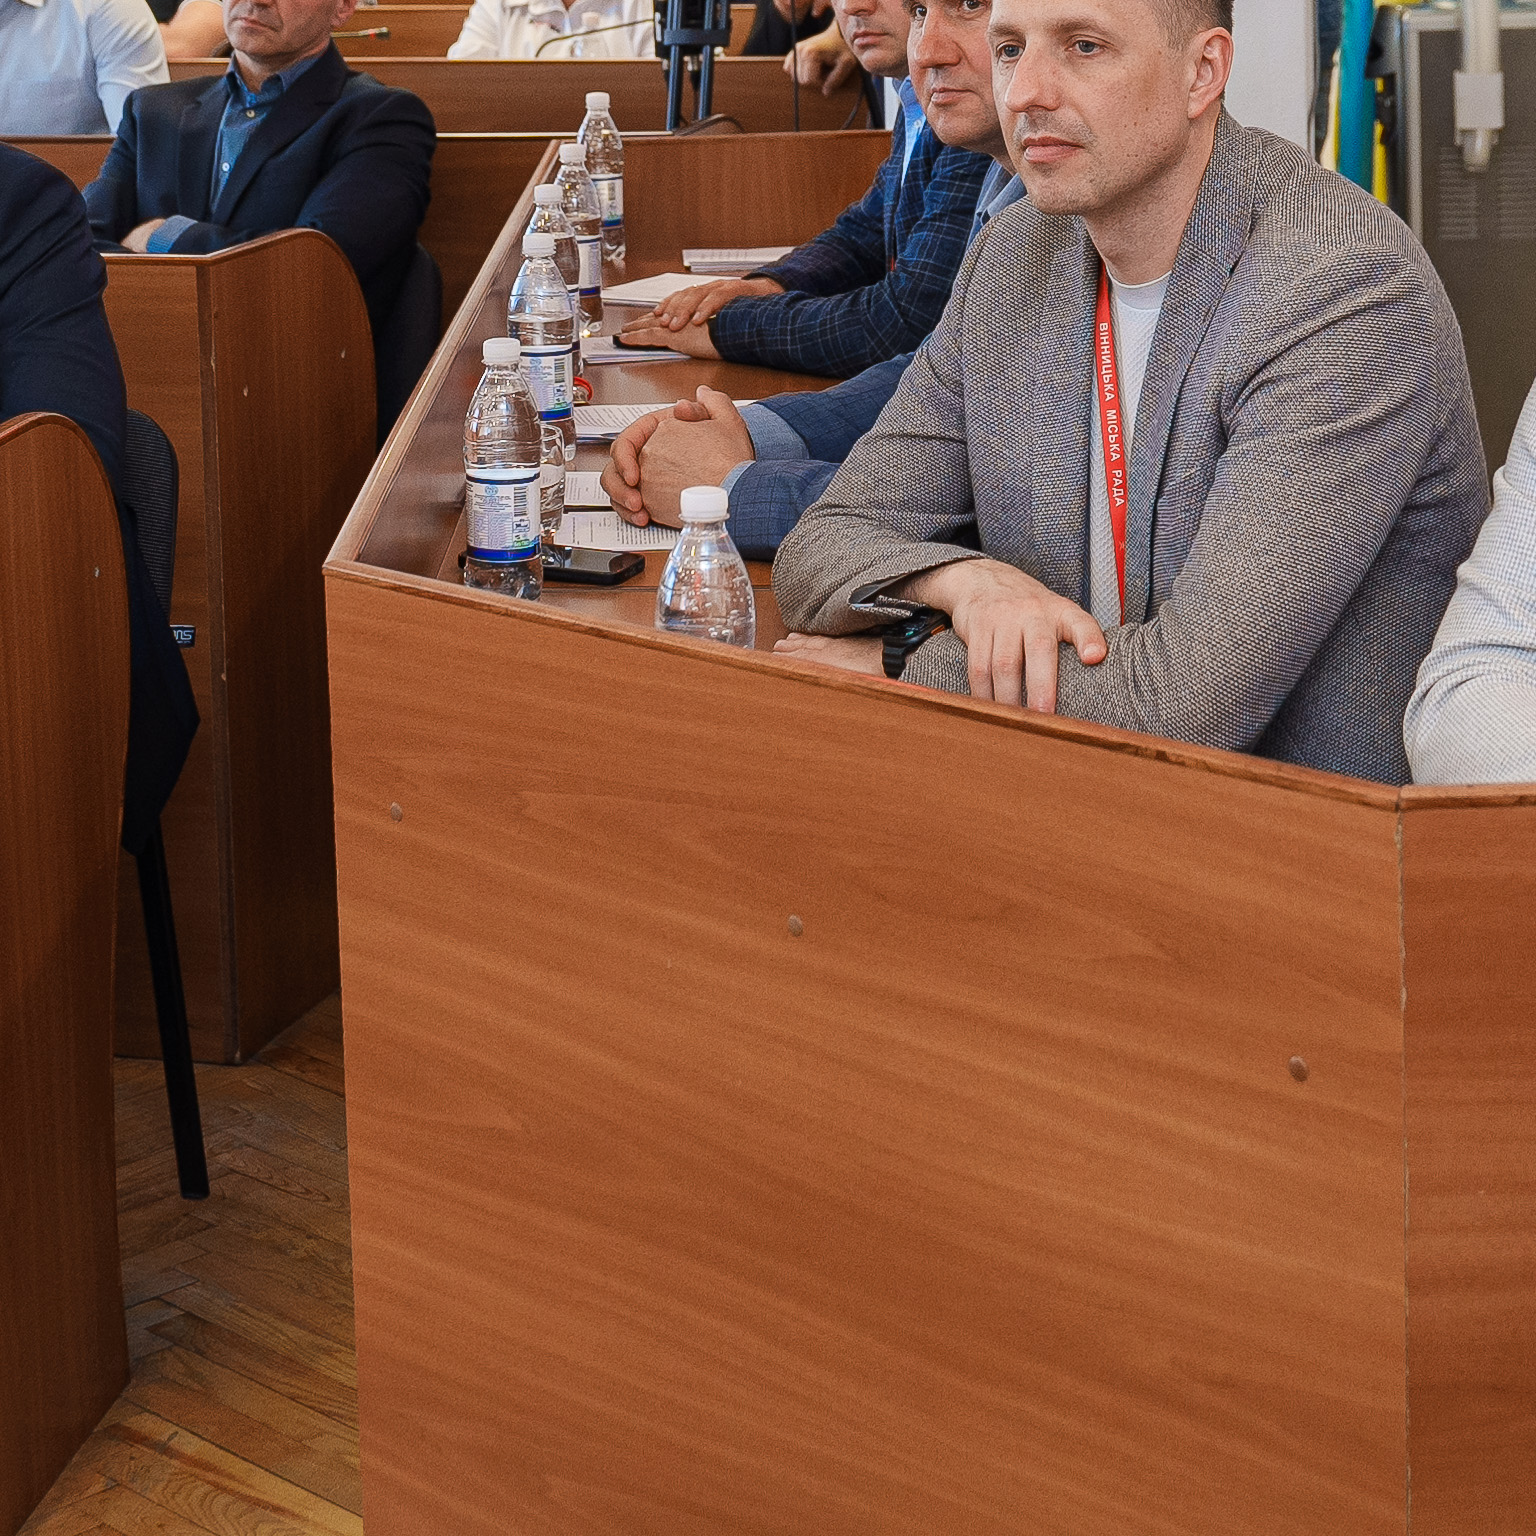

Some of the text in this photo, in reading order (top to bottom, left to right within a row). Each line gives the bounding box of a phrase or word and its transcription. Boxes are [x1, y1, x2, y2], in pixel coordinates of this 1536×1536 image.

[1099, 322, 1125, 507] ВІННИЦЬКА МІСЬКА РАДА
